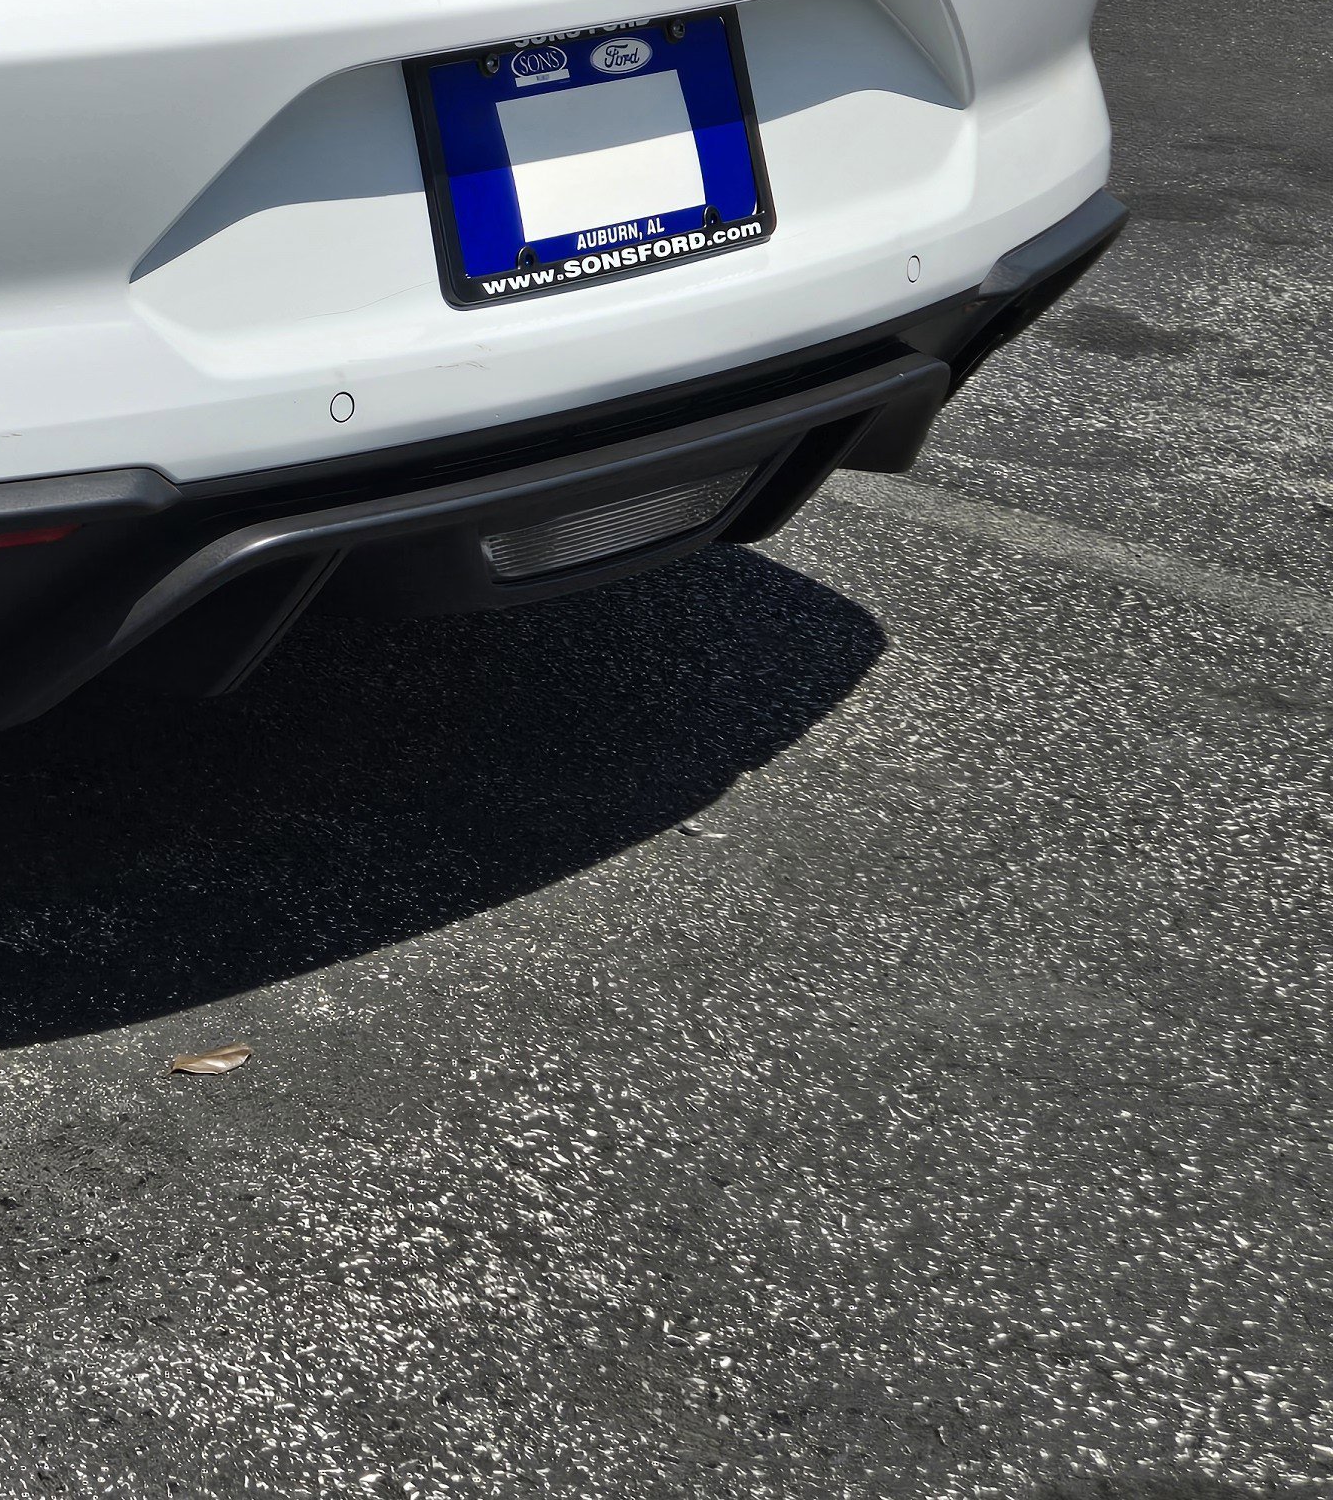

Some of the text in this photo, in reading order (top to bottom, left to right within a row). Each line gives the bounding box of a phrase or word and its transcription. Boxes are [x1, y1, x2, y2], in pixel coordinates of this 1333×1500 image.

[519, 50, 561, 74] SONS
[604, 43, 640, 69] Ford
[576, 217, 665, 250] AUBURN, AL
[482, 221, 763, 295] www.SONSFORD.com
